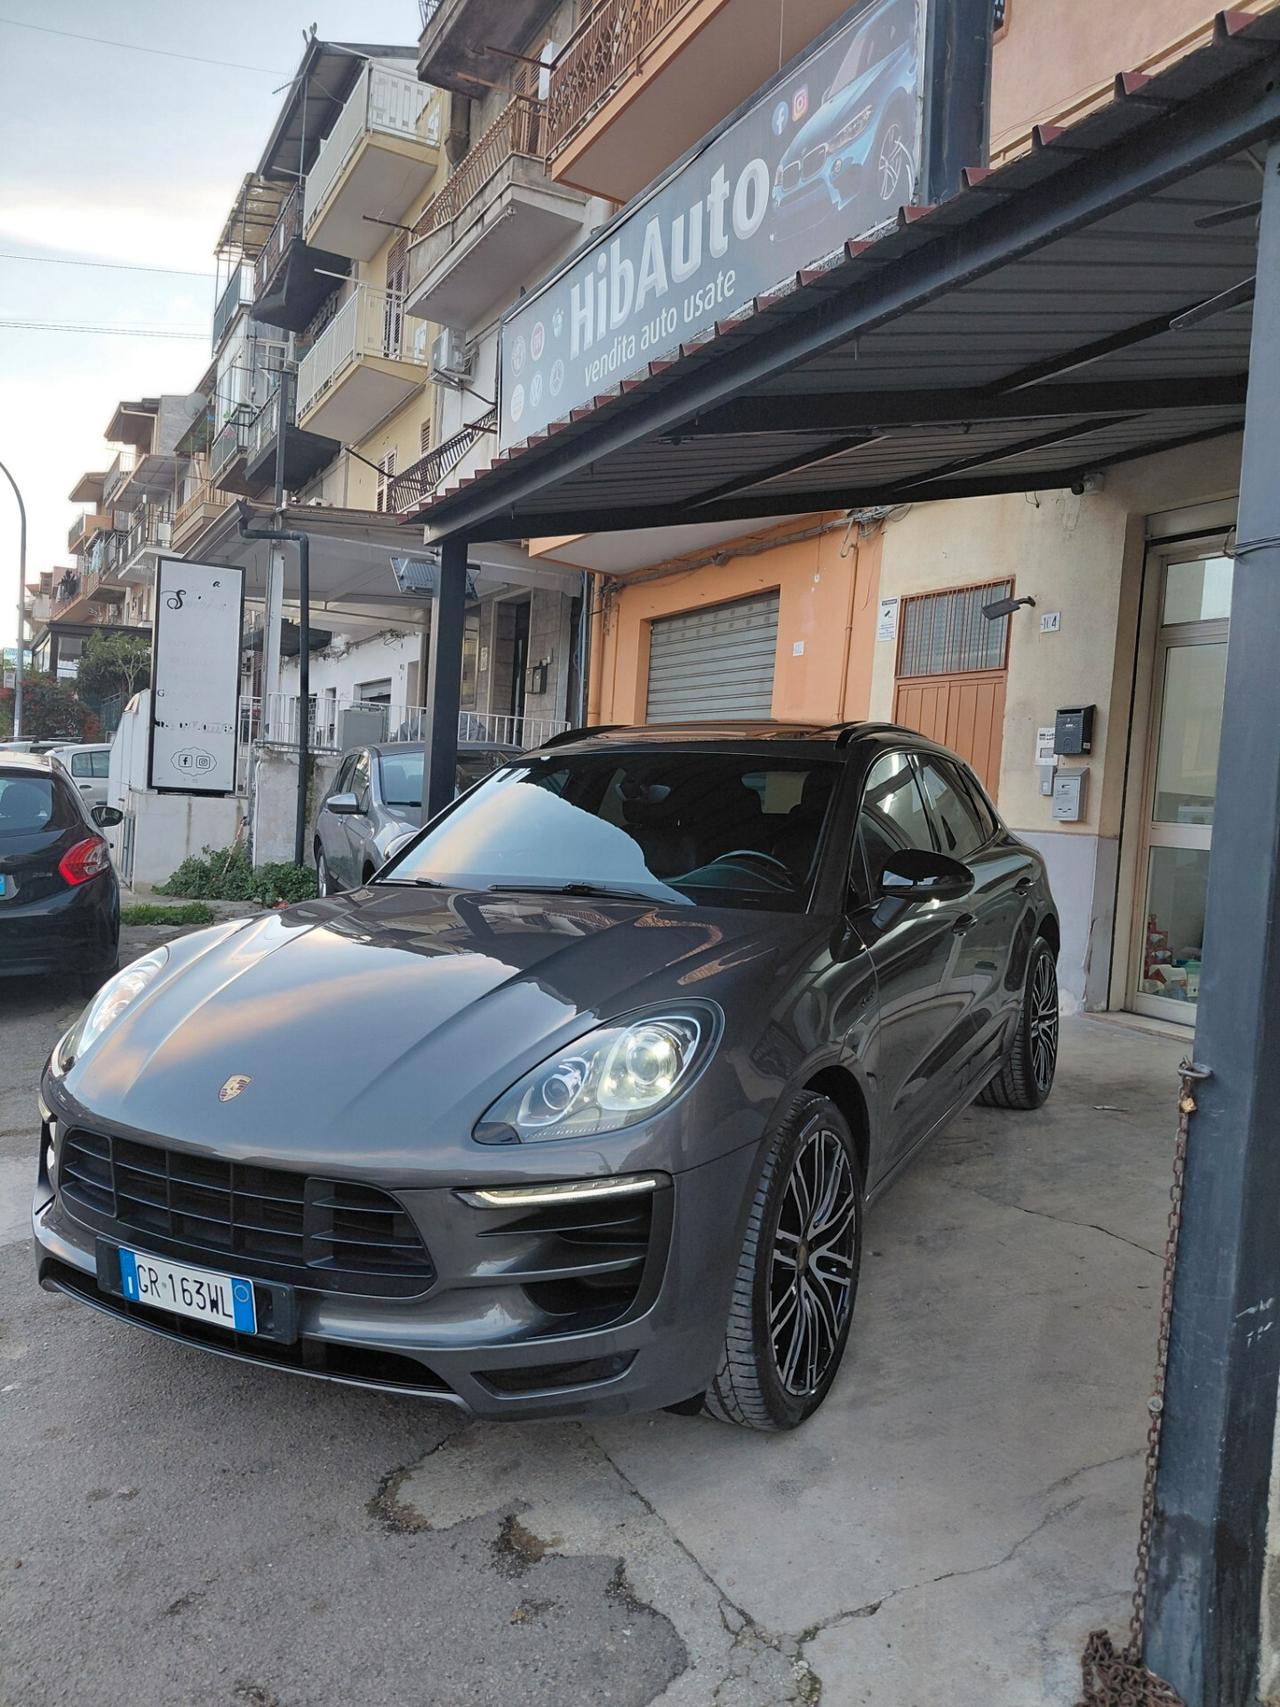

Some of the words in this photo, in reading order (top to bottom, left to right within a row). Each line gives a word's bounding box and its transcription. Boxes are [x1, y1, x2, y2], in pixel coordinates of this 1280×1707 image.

[569, 158, 771, 361] HibAuto
[585, 334, 636, 387] vendita
[640, 306, 677, 350] auto
[684, 269, 736, 323] usate
